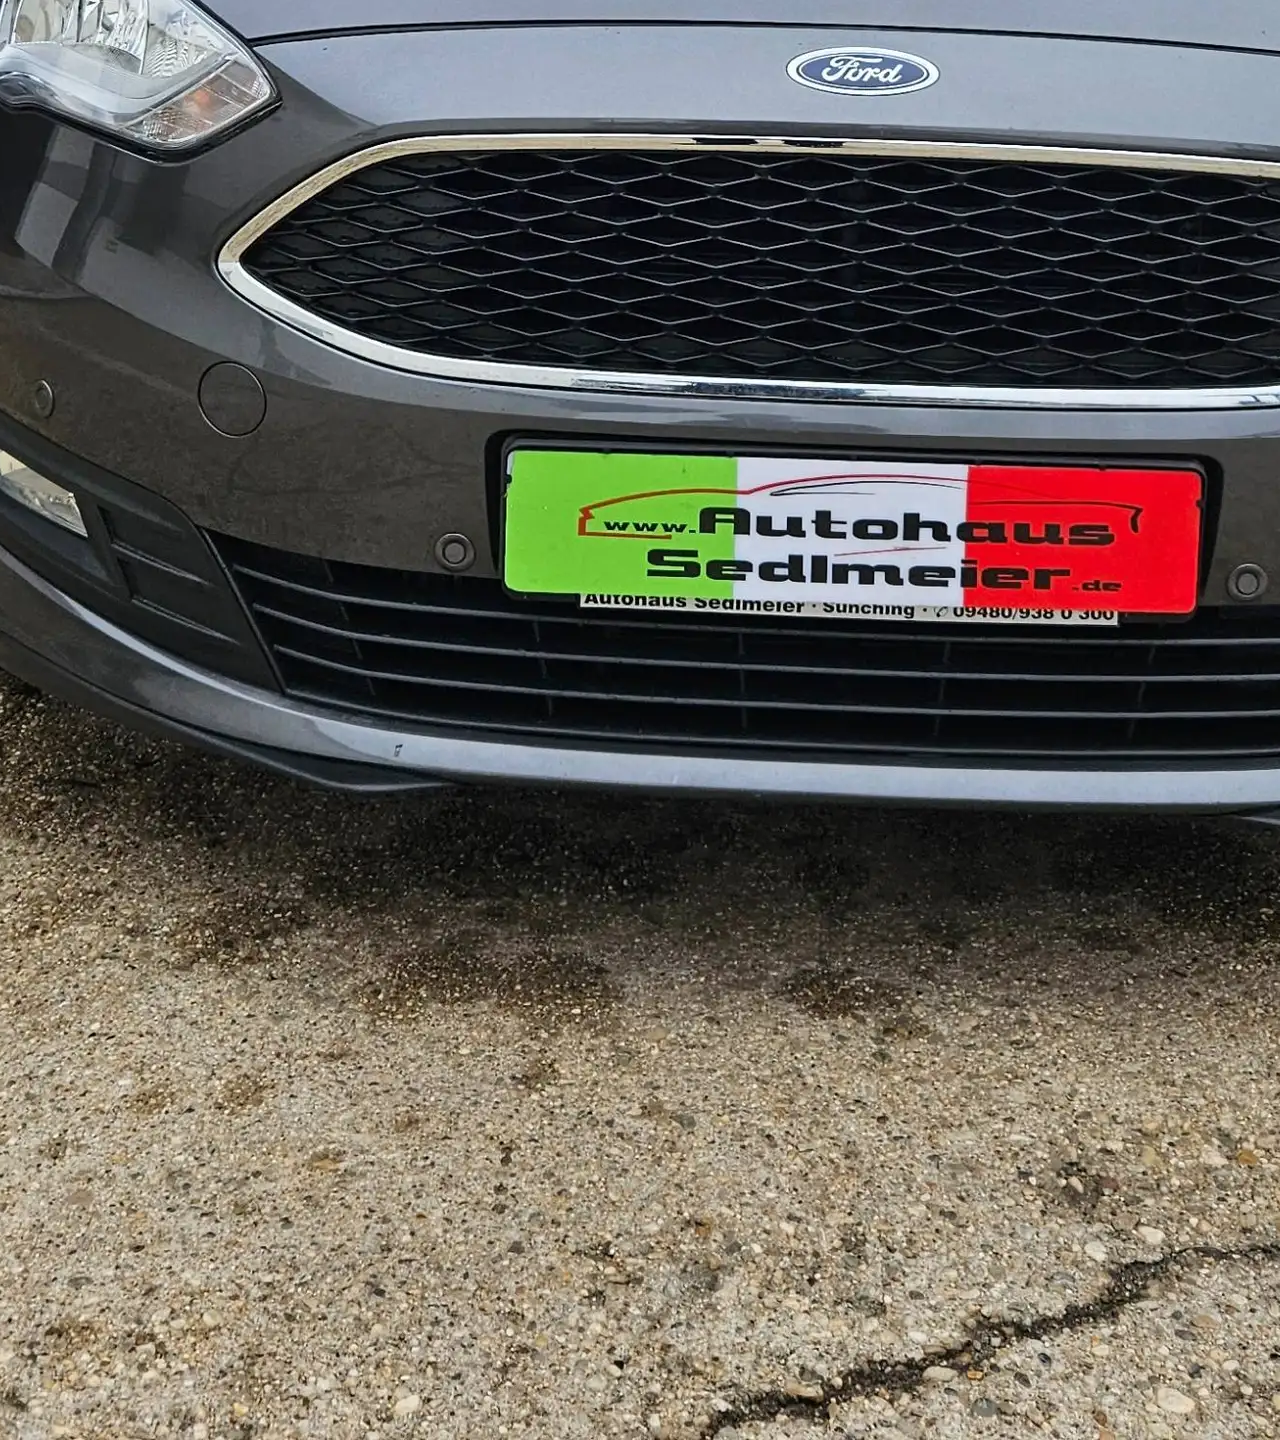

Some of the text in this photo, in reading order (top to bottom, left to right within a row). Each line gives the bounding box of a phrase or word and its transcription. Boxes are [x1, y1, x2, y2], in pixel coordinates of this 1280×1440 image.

[822, 55, 903, 83] Ford
[699, 506, 1115, 546] Autohaus
[647, 548, 1071, 590] Sedlmeier
